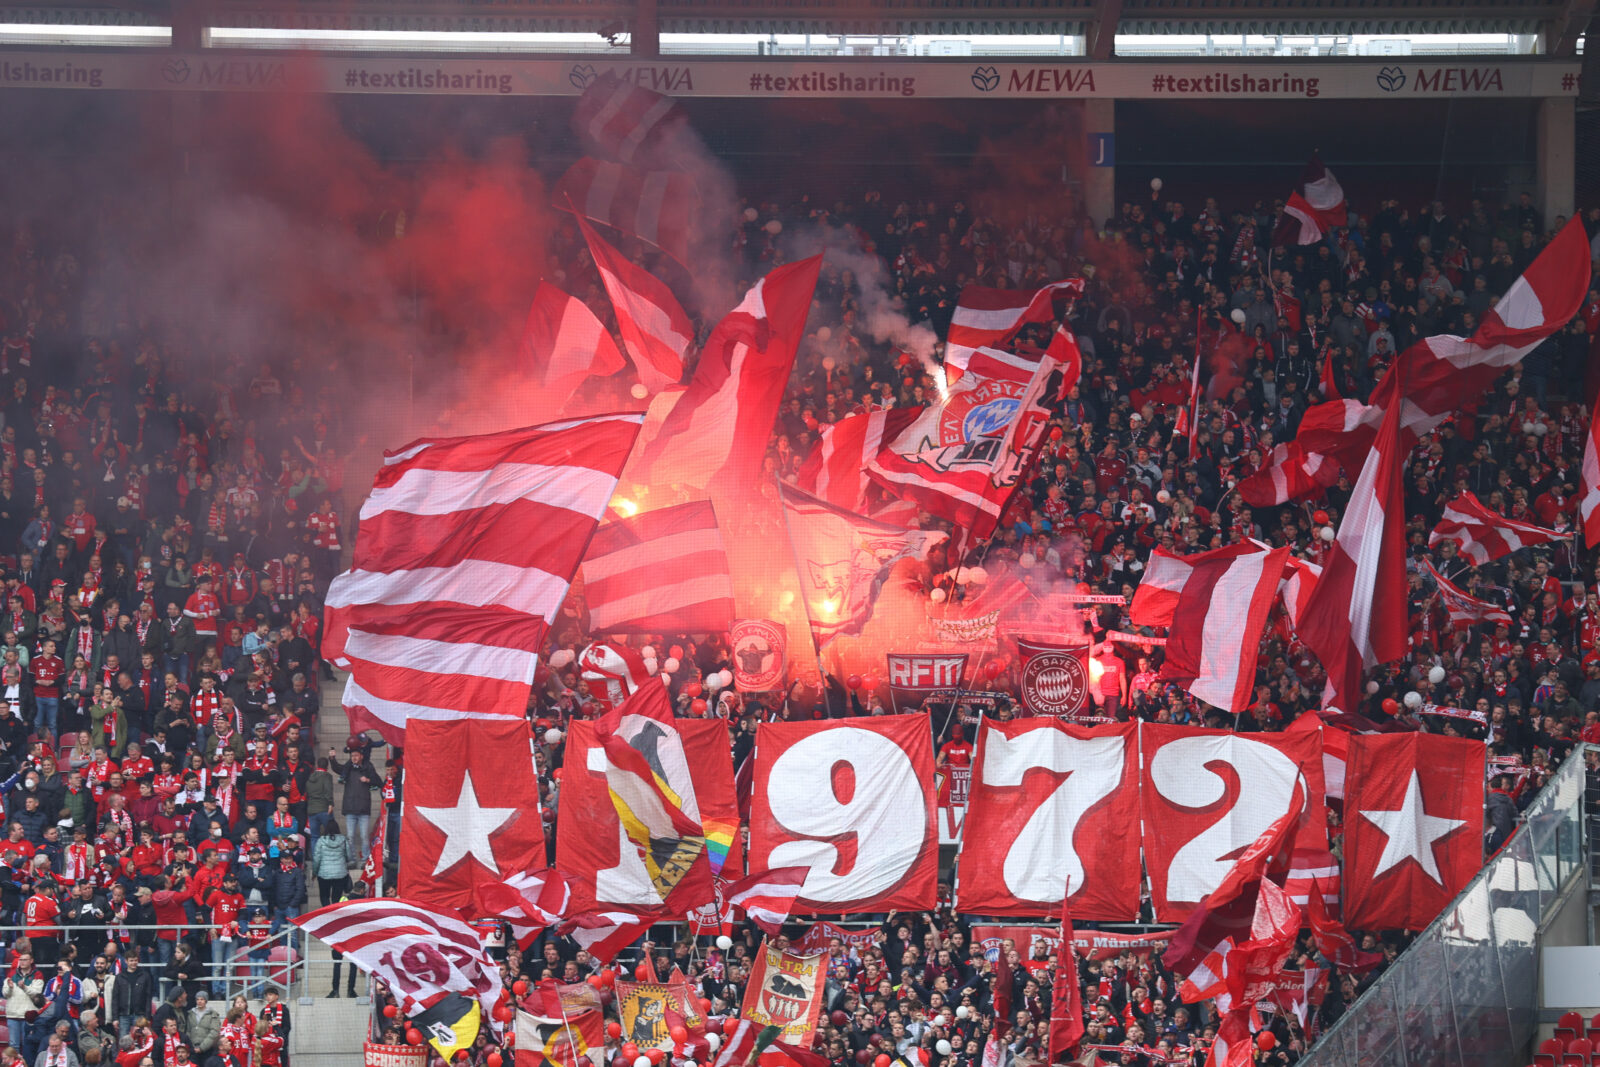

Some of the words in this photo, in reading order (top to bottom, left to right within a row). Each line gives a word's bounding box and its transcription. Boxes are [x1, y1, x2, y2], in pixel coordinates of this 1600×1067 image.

[344, 68, 513, 93] #textilsharing
[749, 71, 915, 97] #textilsharing
[1008, 69, 1096, 92] MEWA
[1152, 72, 1320, 97] #textilsharing
[1413, 68, 1504, 92] MEWA
[1096, 138, 1104, 164] J
[1042, 657, 1080, 677] BAYERN
[1027, 686, 1069, 713] MÜNCHEN
[27, 901, 37, 918] 18
